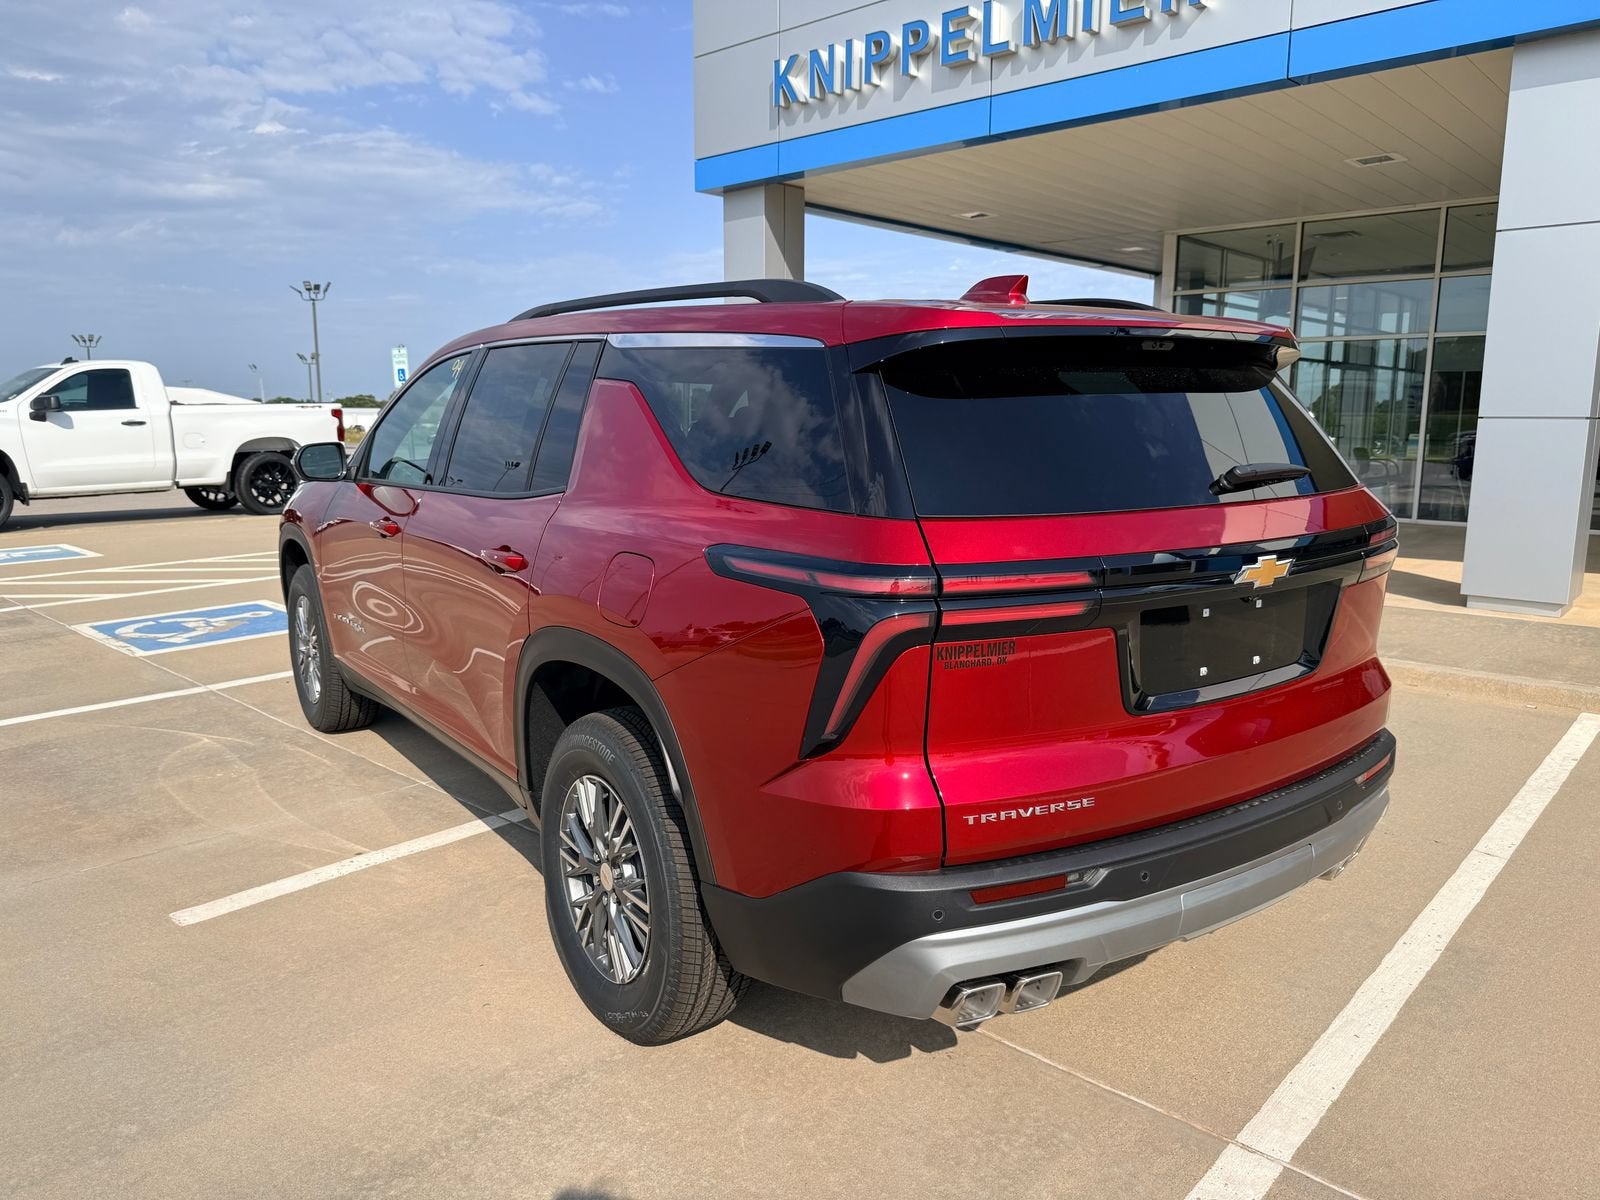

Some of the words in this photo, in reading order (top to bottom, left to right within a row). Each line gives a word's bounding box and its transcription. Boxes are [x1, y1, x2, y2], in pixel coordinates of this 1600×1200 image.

[773, 0, 1206, 108] KNIPPELMI
[936, 641, 1016, 661] KNIPPELMIER
[996, 655, 1008, 665] OK
[962, 797, 1096, 825] TRAVERSE
